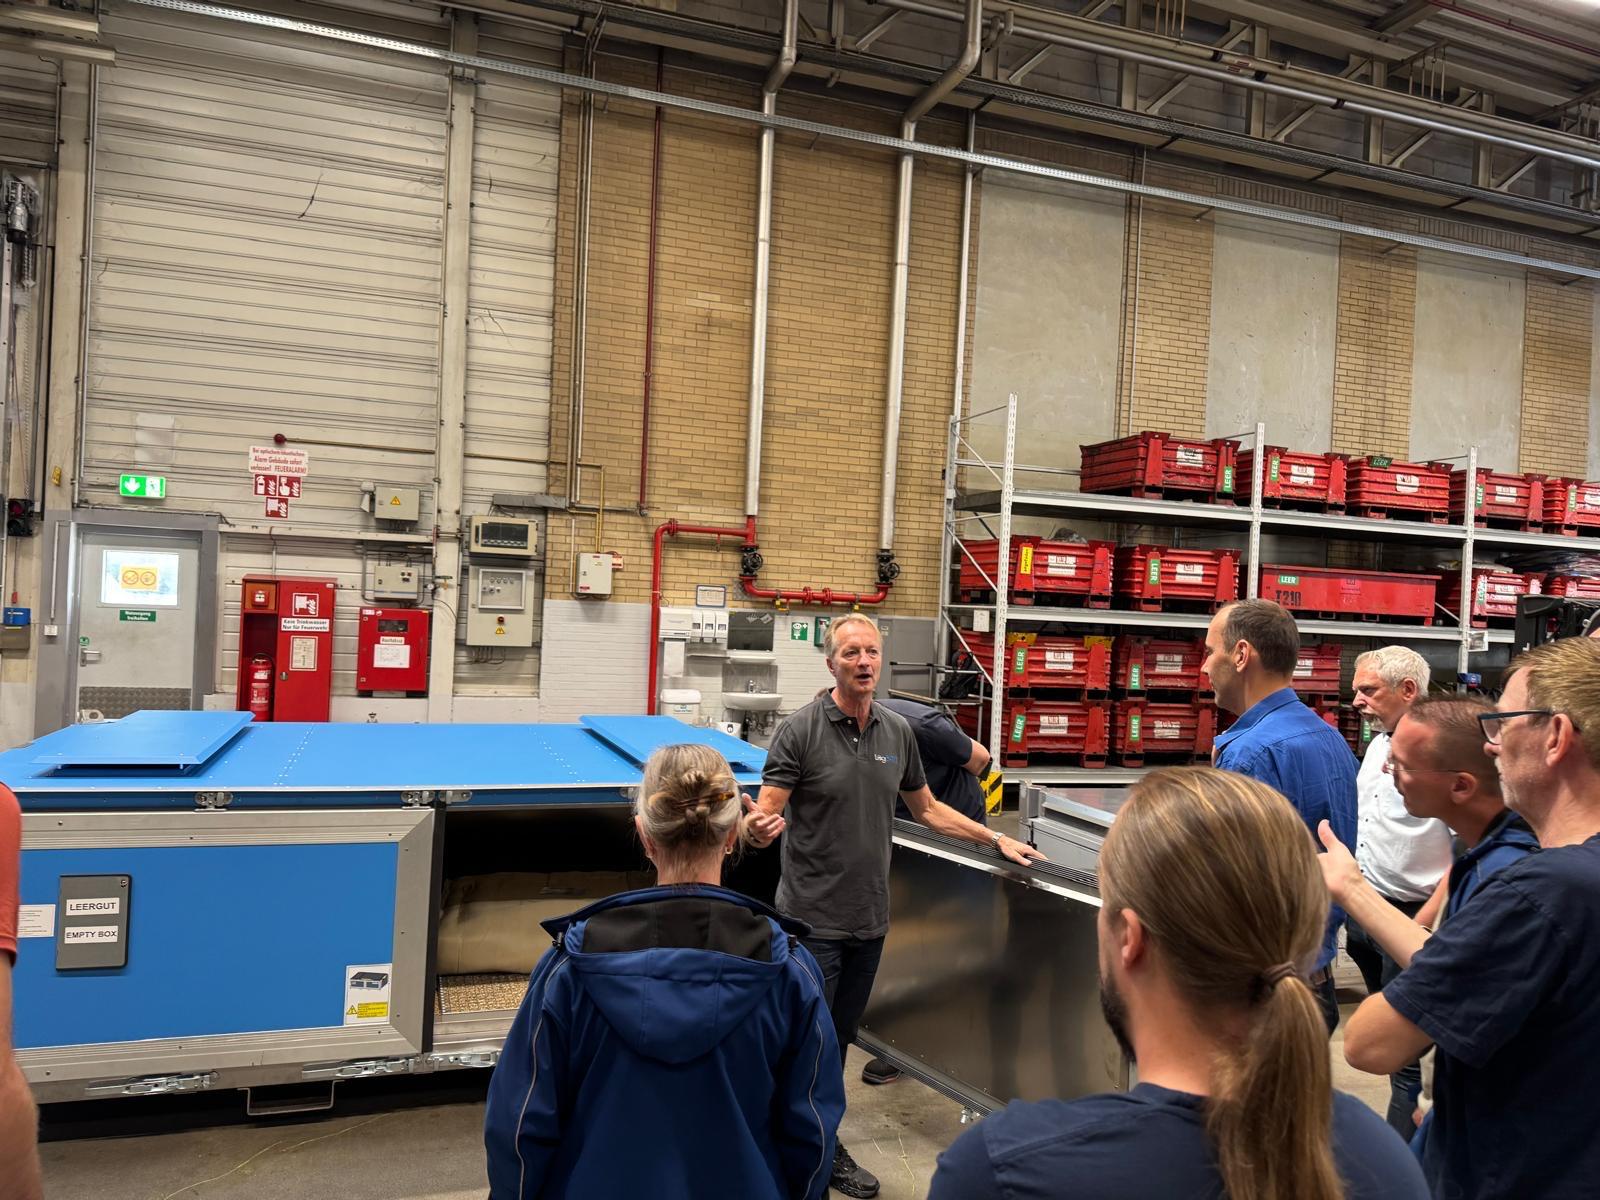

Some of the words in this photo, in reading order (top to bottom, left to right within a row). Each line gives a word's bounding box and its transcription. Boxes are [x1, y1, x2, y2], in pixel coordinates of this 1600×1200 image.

[1271, 459, 1279, 478] LEER
[1224, 469, 1233, 488] LEER
[1151, 562, 1159, 581] LEER
[1281, 575, 1297, 584] LEER
[1017, 650, 1025, 671] LEER
[1131, 667, 1140, 686] LEER
[1014, 718, 1025, 739] LEER
[69, 902, 117, 911] LEERGUT
[66, 931, 95, 939] EMPTY
[98, 930, 117, 938] BOX
